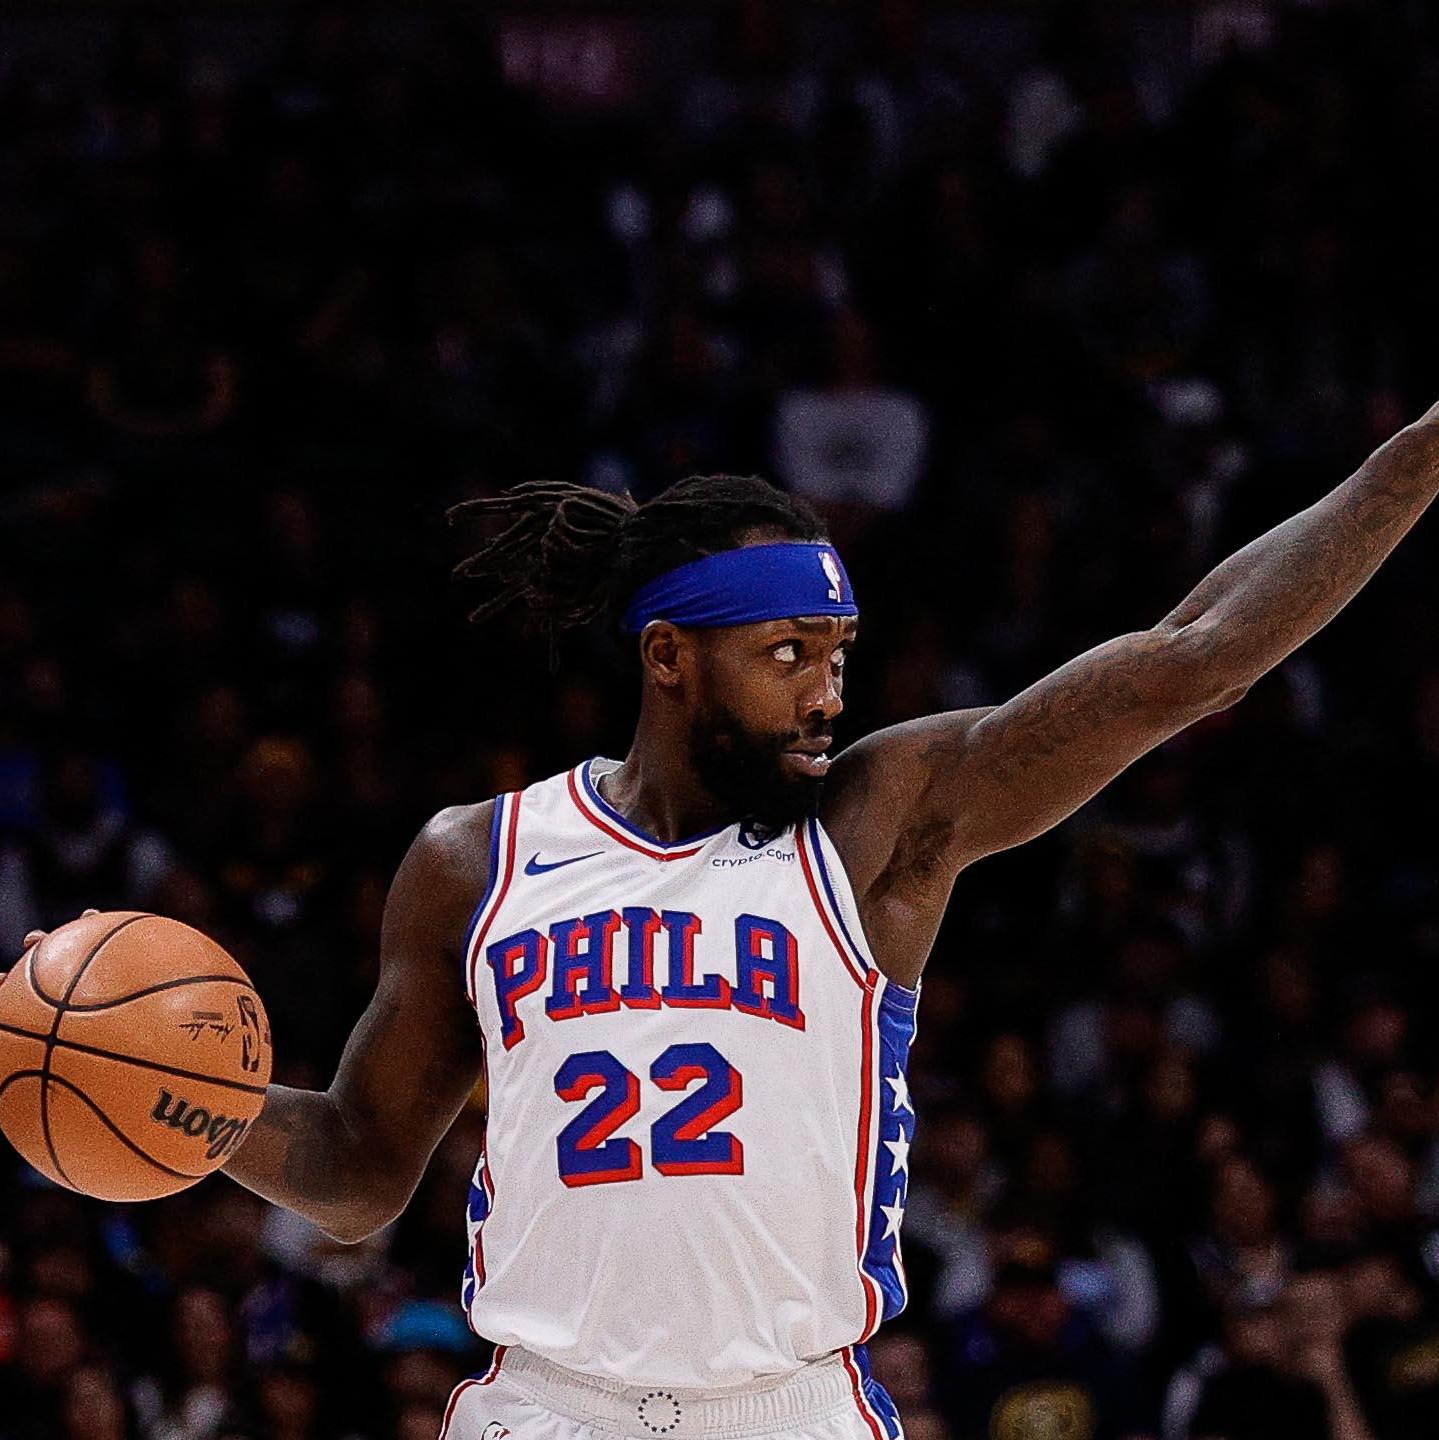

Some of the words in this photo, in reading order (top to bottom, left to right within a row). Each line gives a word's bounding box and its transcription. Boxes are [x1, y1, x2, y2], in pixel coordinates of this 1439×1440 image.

[711, 848, 795, 867] crypto.com
[485, 906, 806, 1051] PHILA
[150, 1086, 249, 1160] lson
[553, 1042, 744, 1188] 22
